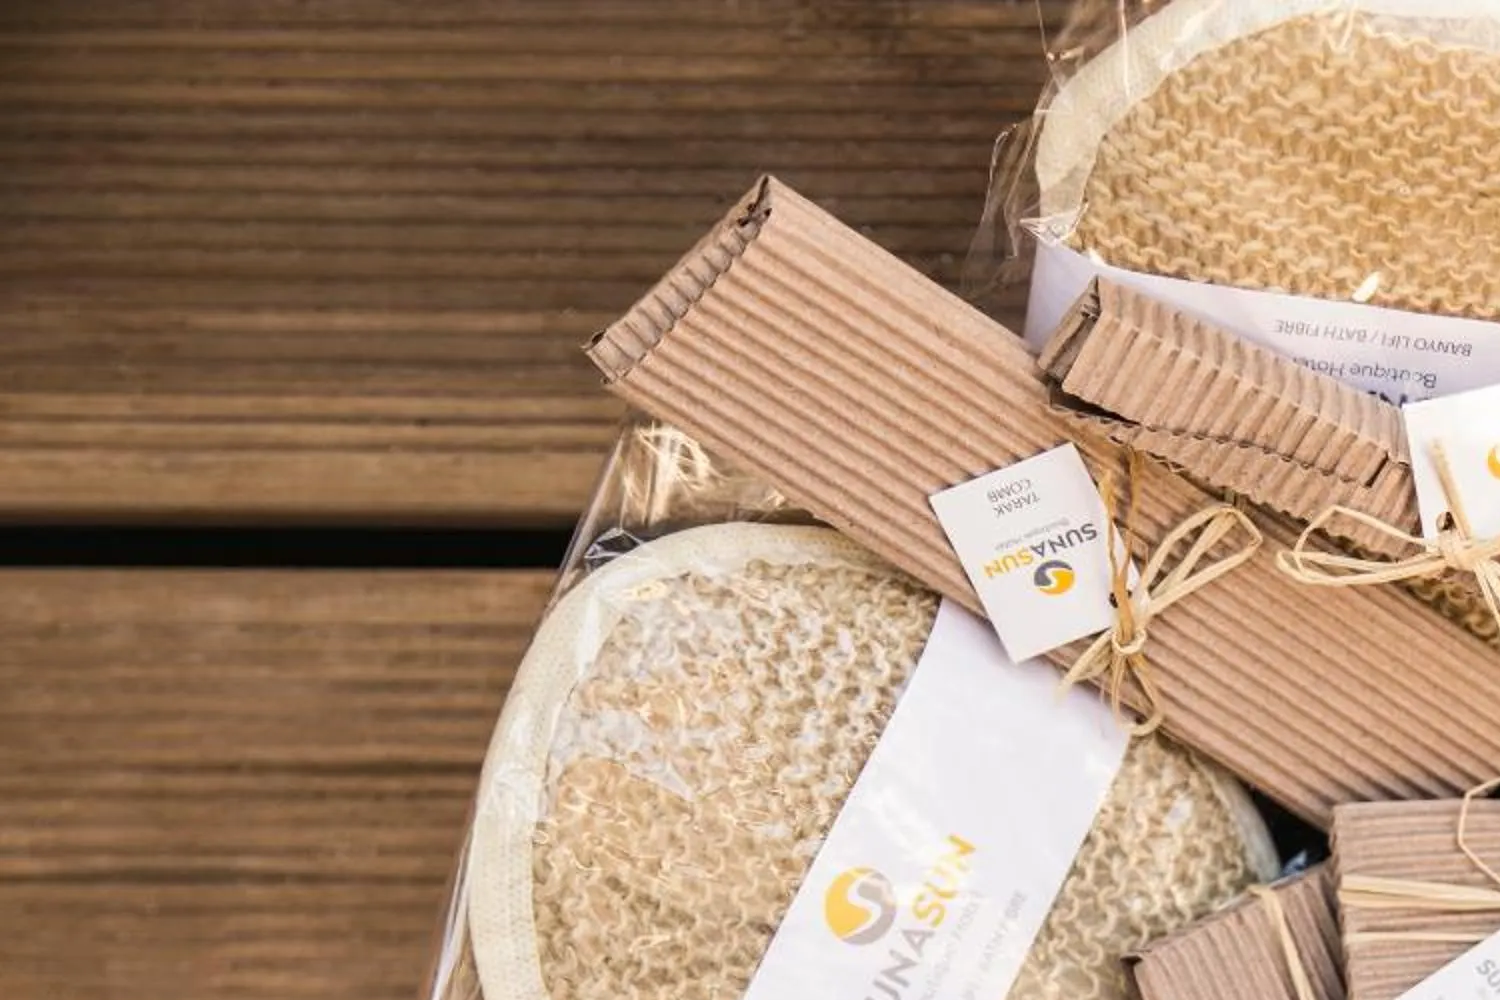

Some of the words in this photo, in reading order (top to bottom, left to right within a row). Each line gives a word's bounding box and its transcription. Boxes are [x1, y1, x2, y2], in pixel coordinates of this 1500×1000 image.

[1274, 319, 1321, 338] FIBRE
[1324, 326, 1369, 343] BATH
[1413, 335, 1473, 357] BANYO
[1350, 361, 1438, 389] Boutique
[994, 492, 1040, 519] TARAK
[983, 522, 1099, 580] SUNASUN
